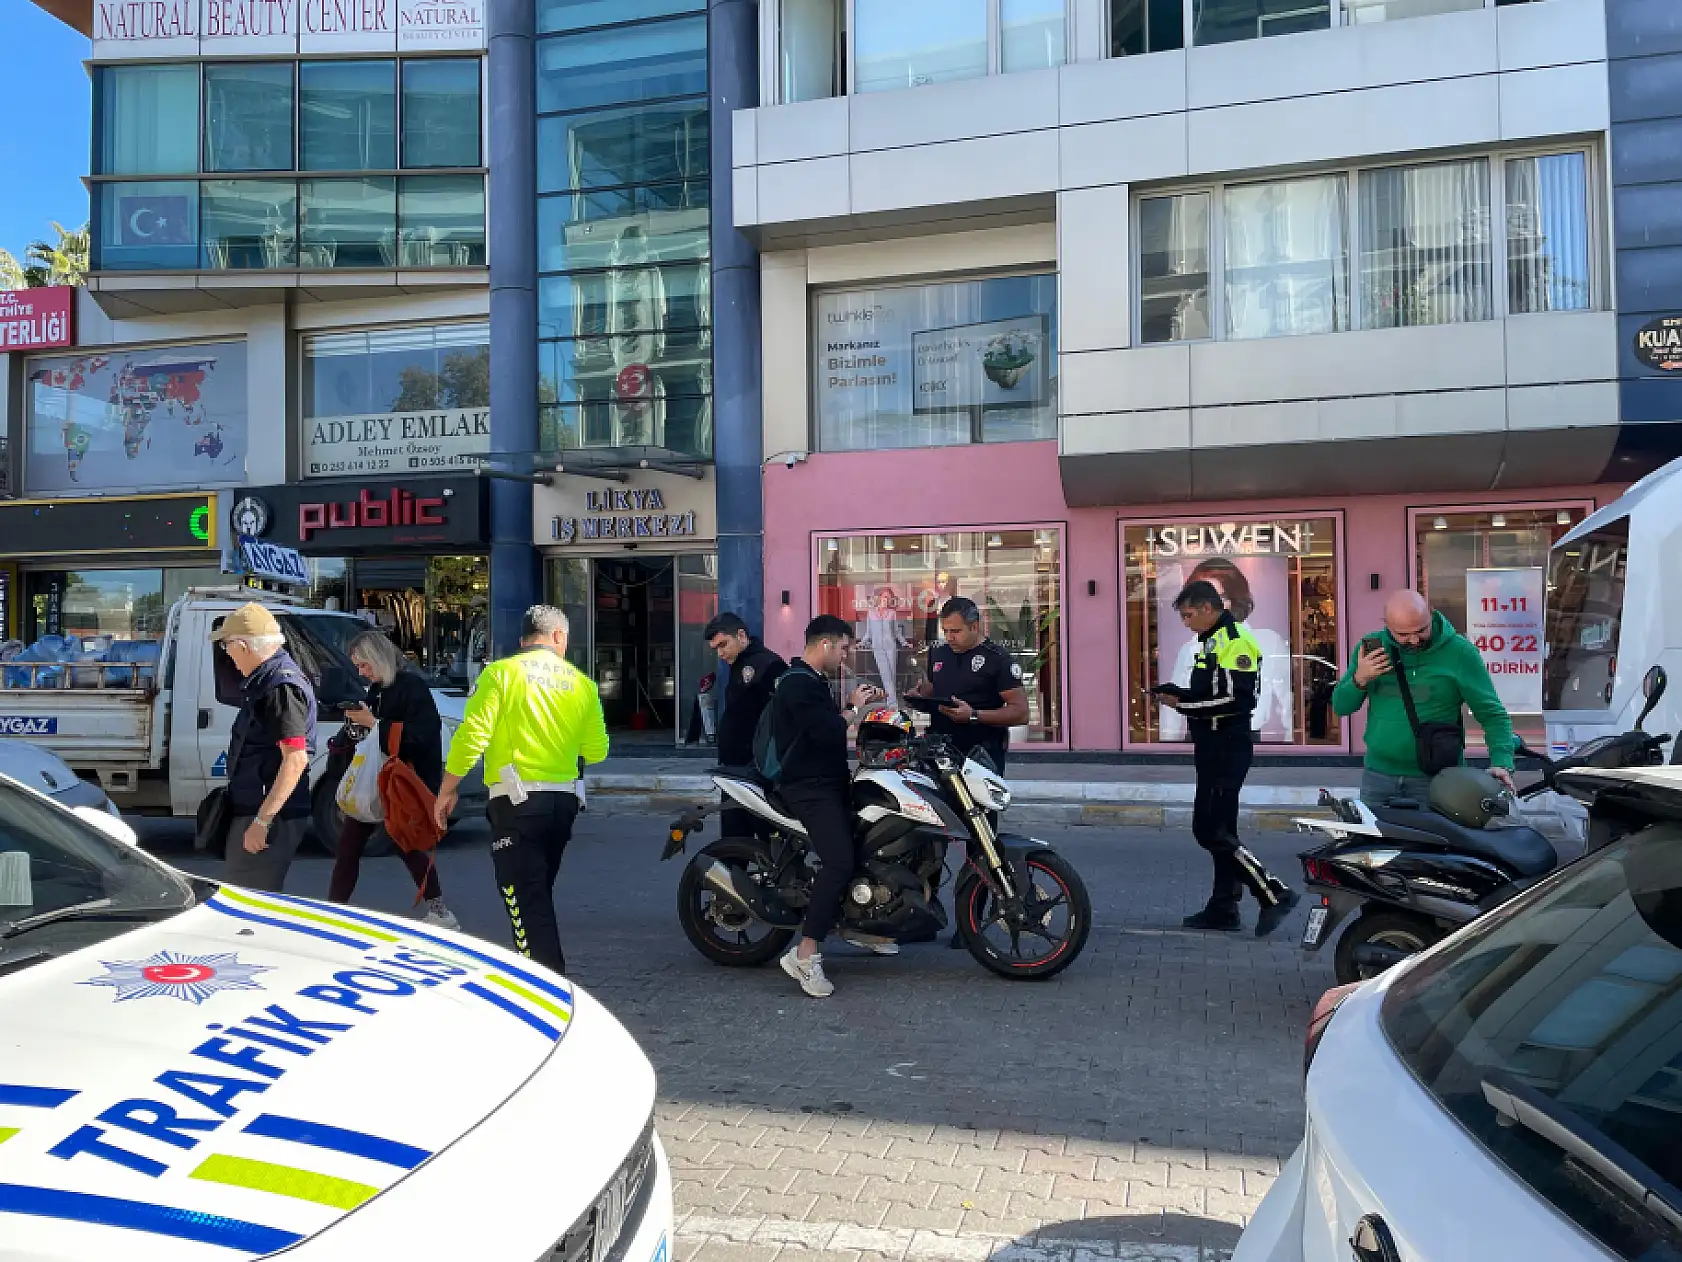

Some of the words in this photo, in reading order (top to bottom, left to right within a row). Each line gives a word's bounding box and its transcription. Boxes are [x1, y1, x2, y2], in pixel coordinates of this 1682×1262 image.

[100, 0, 195, 38] NATURAL
[207, 0, 291, 36] BEAUTY
[306, 0, 387, 33] CENTER
[400, 7, 480, 26] NATURAL
[828, 355, 886, 371] Bizimle
[310, 418, 395, 446] ADLEY
[400, 411, 490, 440] EMLAK
[358, 446, 404, 457] Mehmet
[299, 487, 446, 541] public
[585, 488, 666, 512] LİKYA
[1158, 523, 1302, 557] SUWEN
[1486, 658, 1540, 674] DİRİM
[46, 1004, 354, 1178] TRAFİK
[295, 944, 468, 1015] POLİS
